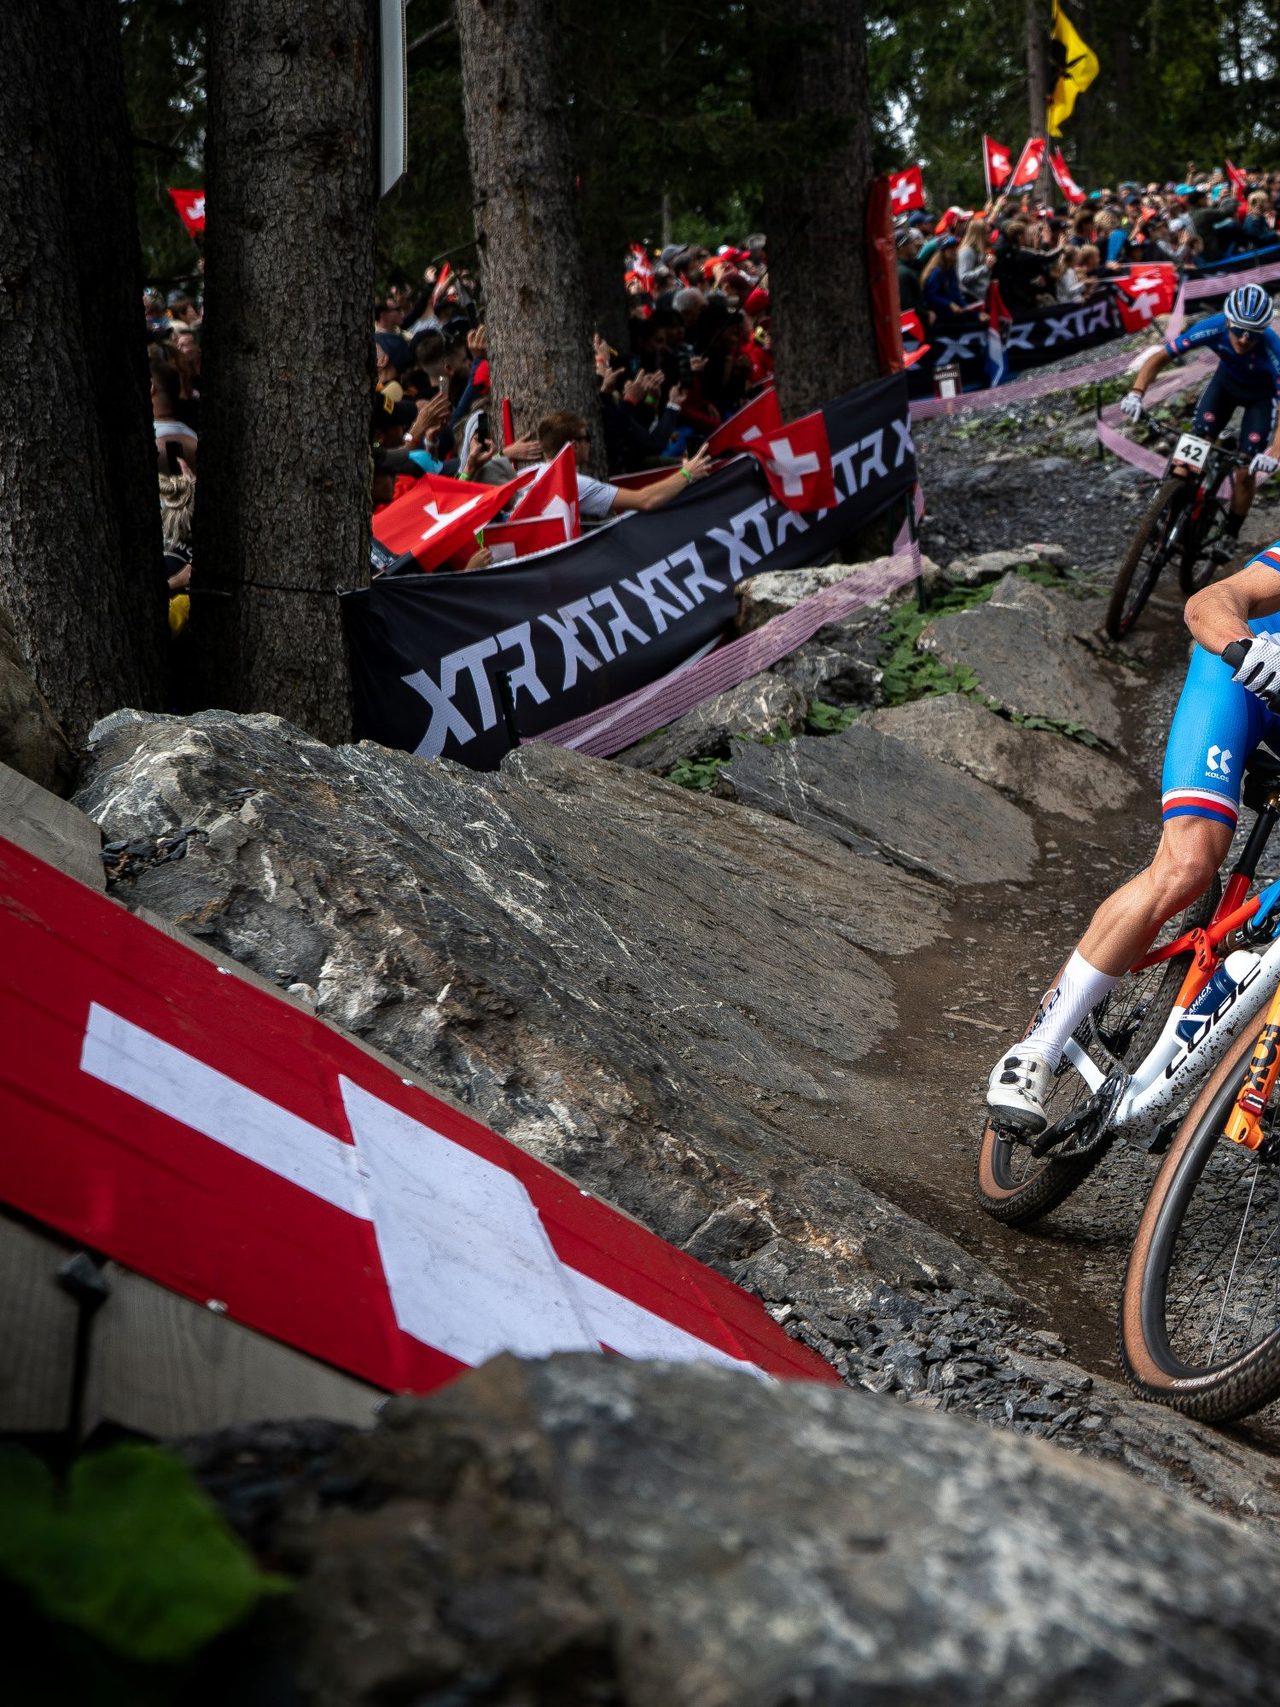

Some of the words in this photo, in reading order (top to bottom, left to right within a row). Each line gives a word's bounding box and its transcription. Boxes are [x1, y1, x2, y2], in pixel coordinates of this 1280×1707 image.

[1045, 301, 1110, 346] XTR
[1181, 444, 1203, 462] 42
[401, 620, 551, 761] XTR
[538, 585, 652, 692] XTR
[620, 542, 727, 635] XTR
[1205, 770, 1230, 783] KOLOS
[1165, 959, 1261, 1079] CUBE
